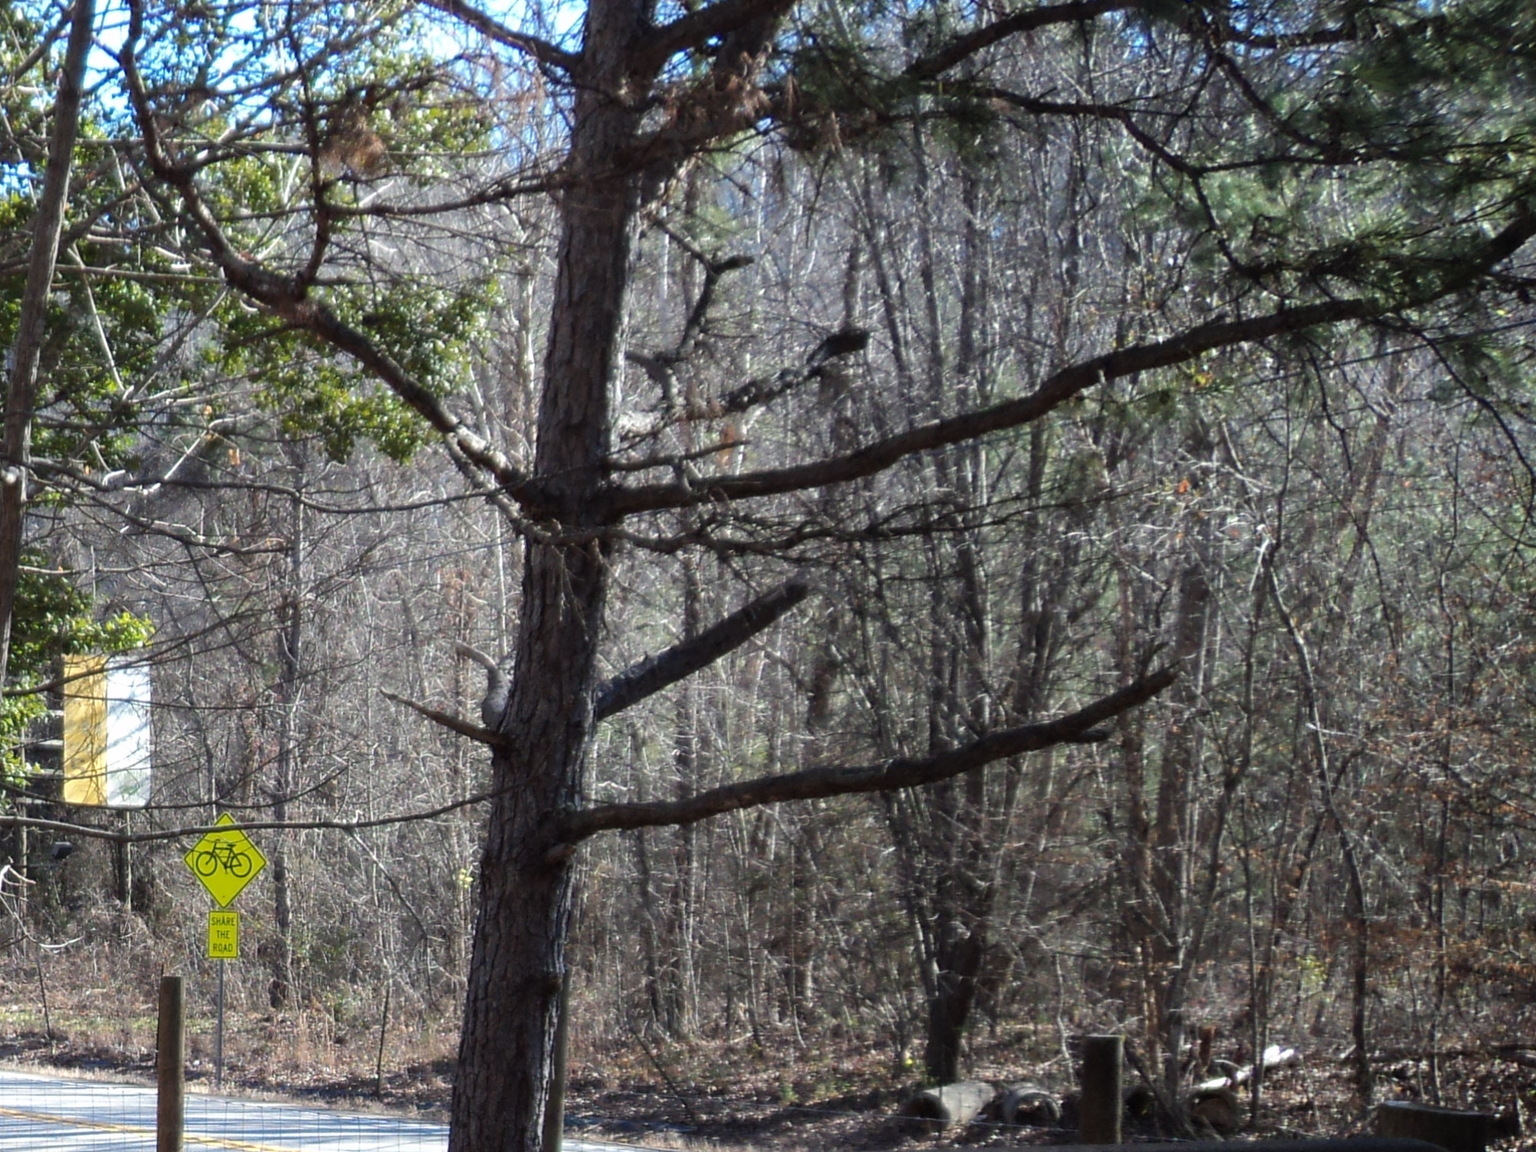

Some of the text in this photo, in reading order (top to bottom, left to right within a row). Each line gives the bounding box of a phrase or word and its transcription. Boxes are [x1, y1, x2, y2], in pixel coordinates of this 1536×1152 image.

[212, 916, 235, 926] SHARE
[216, 930, 230, 939] THE
[213, 943, 233, 952] ROAD
